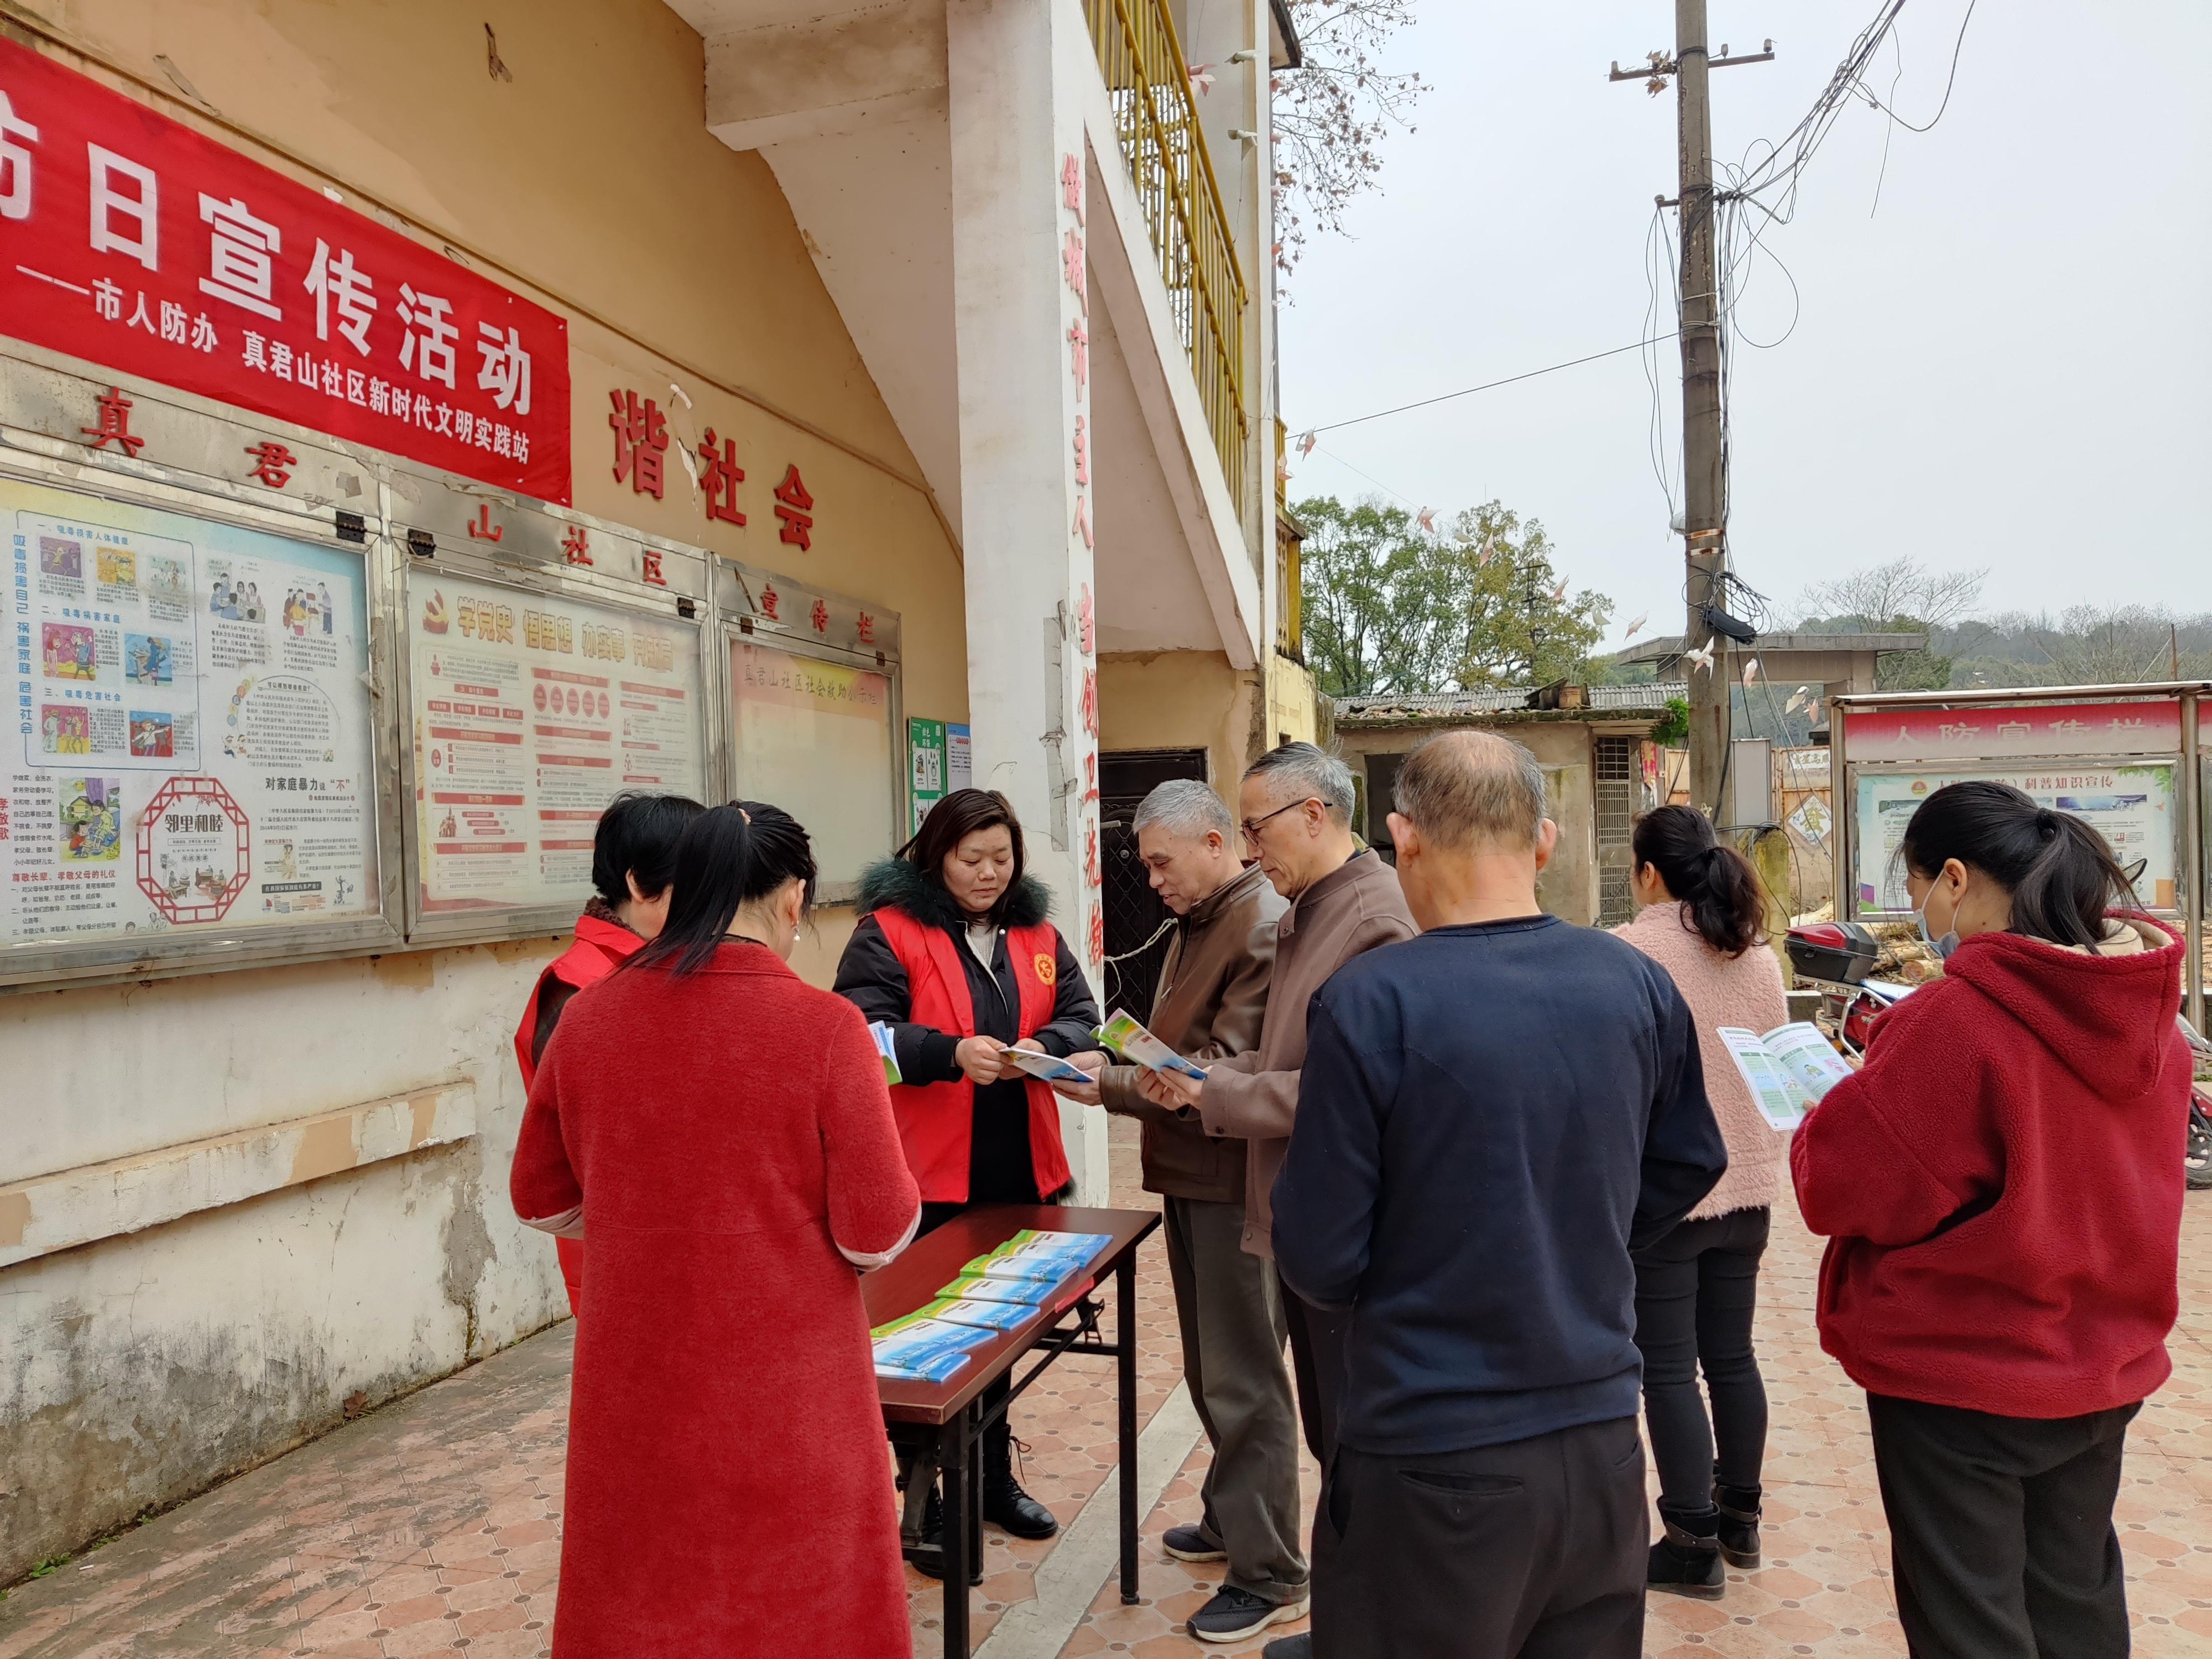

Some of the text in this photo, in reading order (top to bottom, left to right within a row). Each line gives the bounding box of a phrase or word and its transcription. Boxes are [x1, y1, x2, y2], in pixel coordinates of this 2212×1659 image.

[242, 330, 529, 465] 真君山社区新时代文明实践站
[609, 388, 814, 551] 谐社会
[13, 534, 32, 734] 吸毒损害自己 祸害家庭 危害社会
[457, 597, 513, 644] 学党史
[523, 609, 573, 654] 悟思想
[582, 622, 625, 662] 办实事
[1892, 717, 2146, 748] 人防宣传栏
[265, 778, 326, 791] 对家庭暴力说
[165, 814, 223, 833] 邻里和睦
[12, 869, 116, 882] 尊敬长辈、孝敬父母的礼仪
